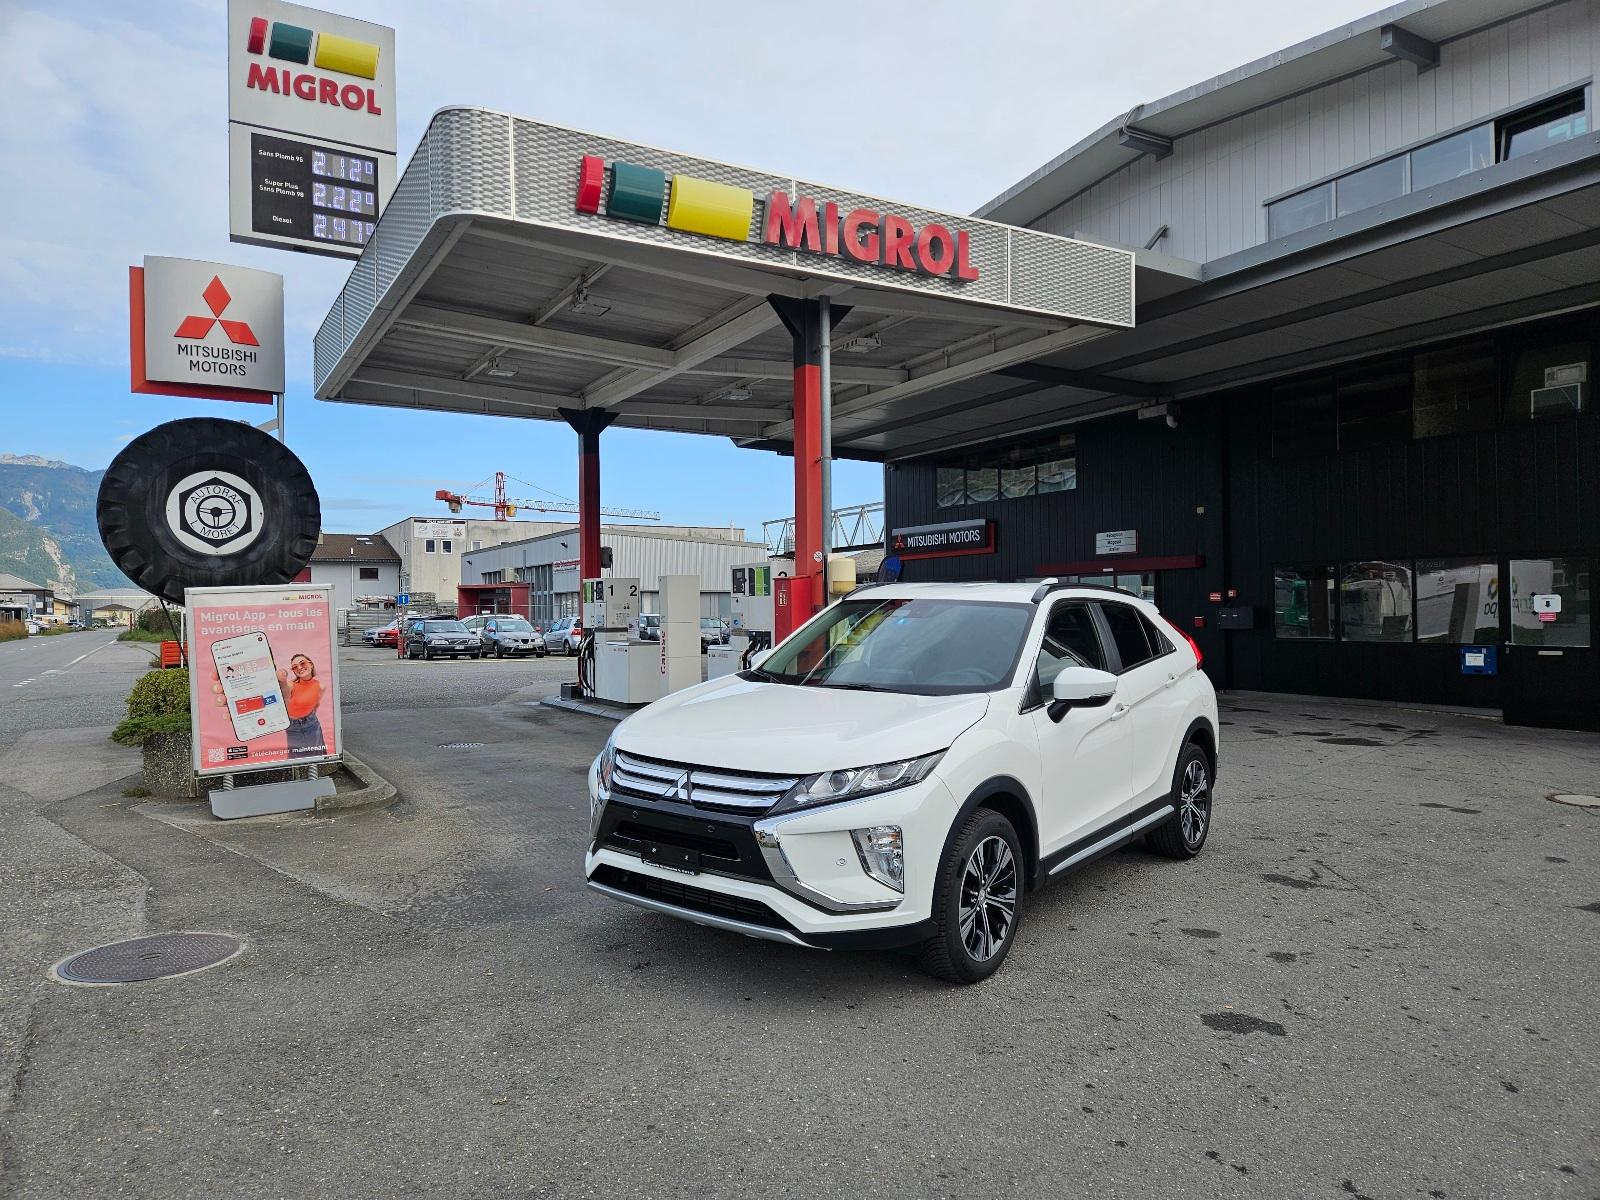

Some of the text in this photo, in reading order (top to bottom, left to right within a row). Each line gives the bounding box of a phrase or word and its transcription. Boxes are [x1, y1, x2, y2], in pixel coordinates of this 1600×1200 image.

[247, 63, 382, 115] MIGROL
[258, 149, 274, 158] Sans
[275, 152, 295, 161] Plomb
[259, 184, 275, 193] Sans
[275, 188, 296, 196] Plomb
[264, 178, 299, 190] Super Plus
[272, 215, 293, 224] Diesel
[760, 190, 979, 283] MIGROL
[177, 343, 257, 363] MITSUBISHI
[189, 359, 247, 376] MOTORS
[199, 521, 240, 539] MORET
[907, 529, 981, 548] MITSUBISHI MOTORS
[607, 584, 638, 597] 1 2
[200, 611, 241, 623] Migrol
[243, 610, 266, 622] App
[278, 609, 304, 618] tous
[306, 607, 323, 617] les
[201, 620, 316, 635] avantages en main
